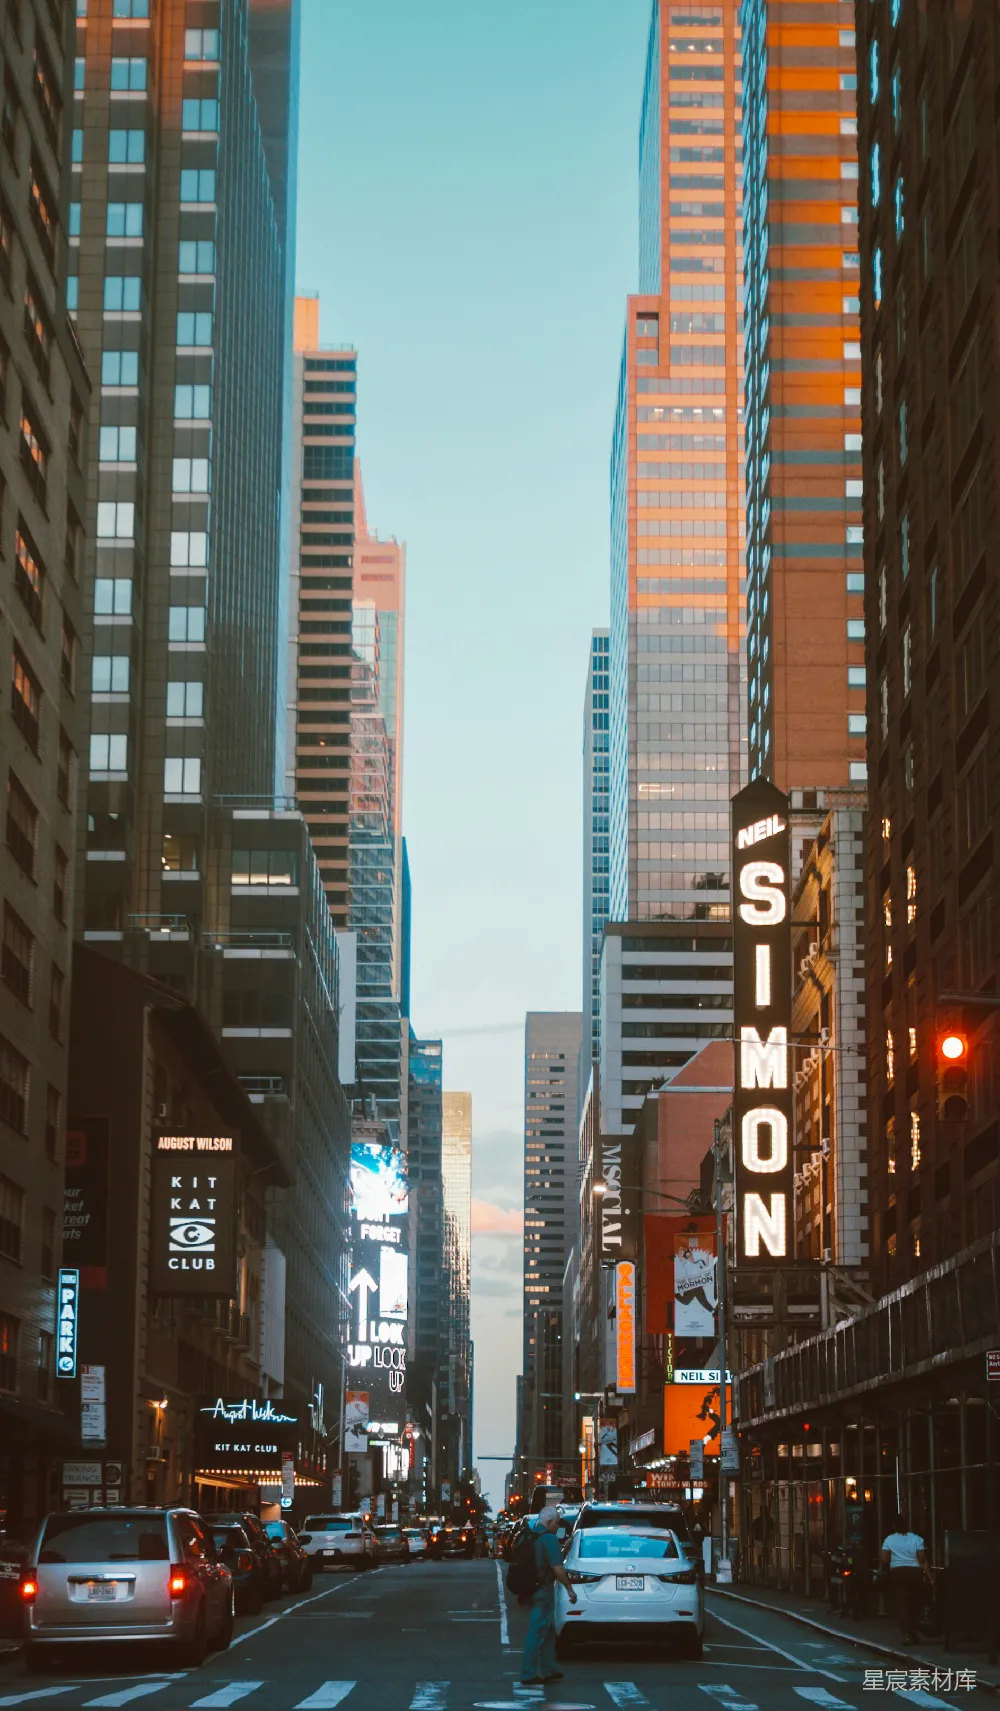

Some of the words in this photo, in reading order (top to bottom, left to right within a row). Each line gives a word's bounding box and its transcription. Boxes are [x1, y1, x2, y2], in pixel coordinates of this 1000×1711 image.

[738, 814, 786, 850] NEIL
[739, 861, 788, 1257] SIMON
[158, 1137, 195, 1150] AUGUST
[197, 1138, 232, 1150] WILSON
[171, 1176, 217, 1189] KIT
[171, 1198, 216, 1210] KAT
[360, 1224, 402, 1243] FORGET
[168, 1258, 216, 1270] CLUB
[677, 1276, 713, 1292] MORMON
[60, 1288, 75, 1352] PARK
[370, 1320, 405, 1344] LOOK
[348, 1344, 372, 1367] UP
[373, 1346, 406, 1370] LOOK
[389, 1371, 405, 1392] UP
[681, 1372, 705, 1380] NEIL
[233, 1444, 251, 1452] KAT
[255, 1445, 278, 1453] CLUB
